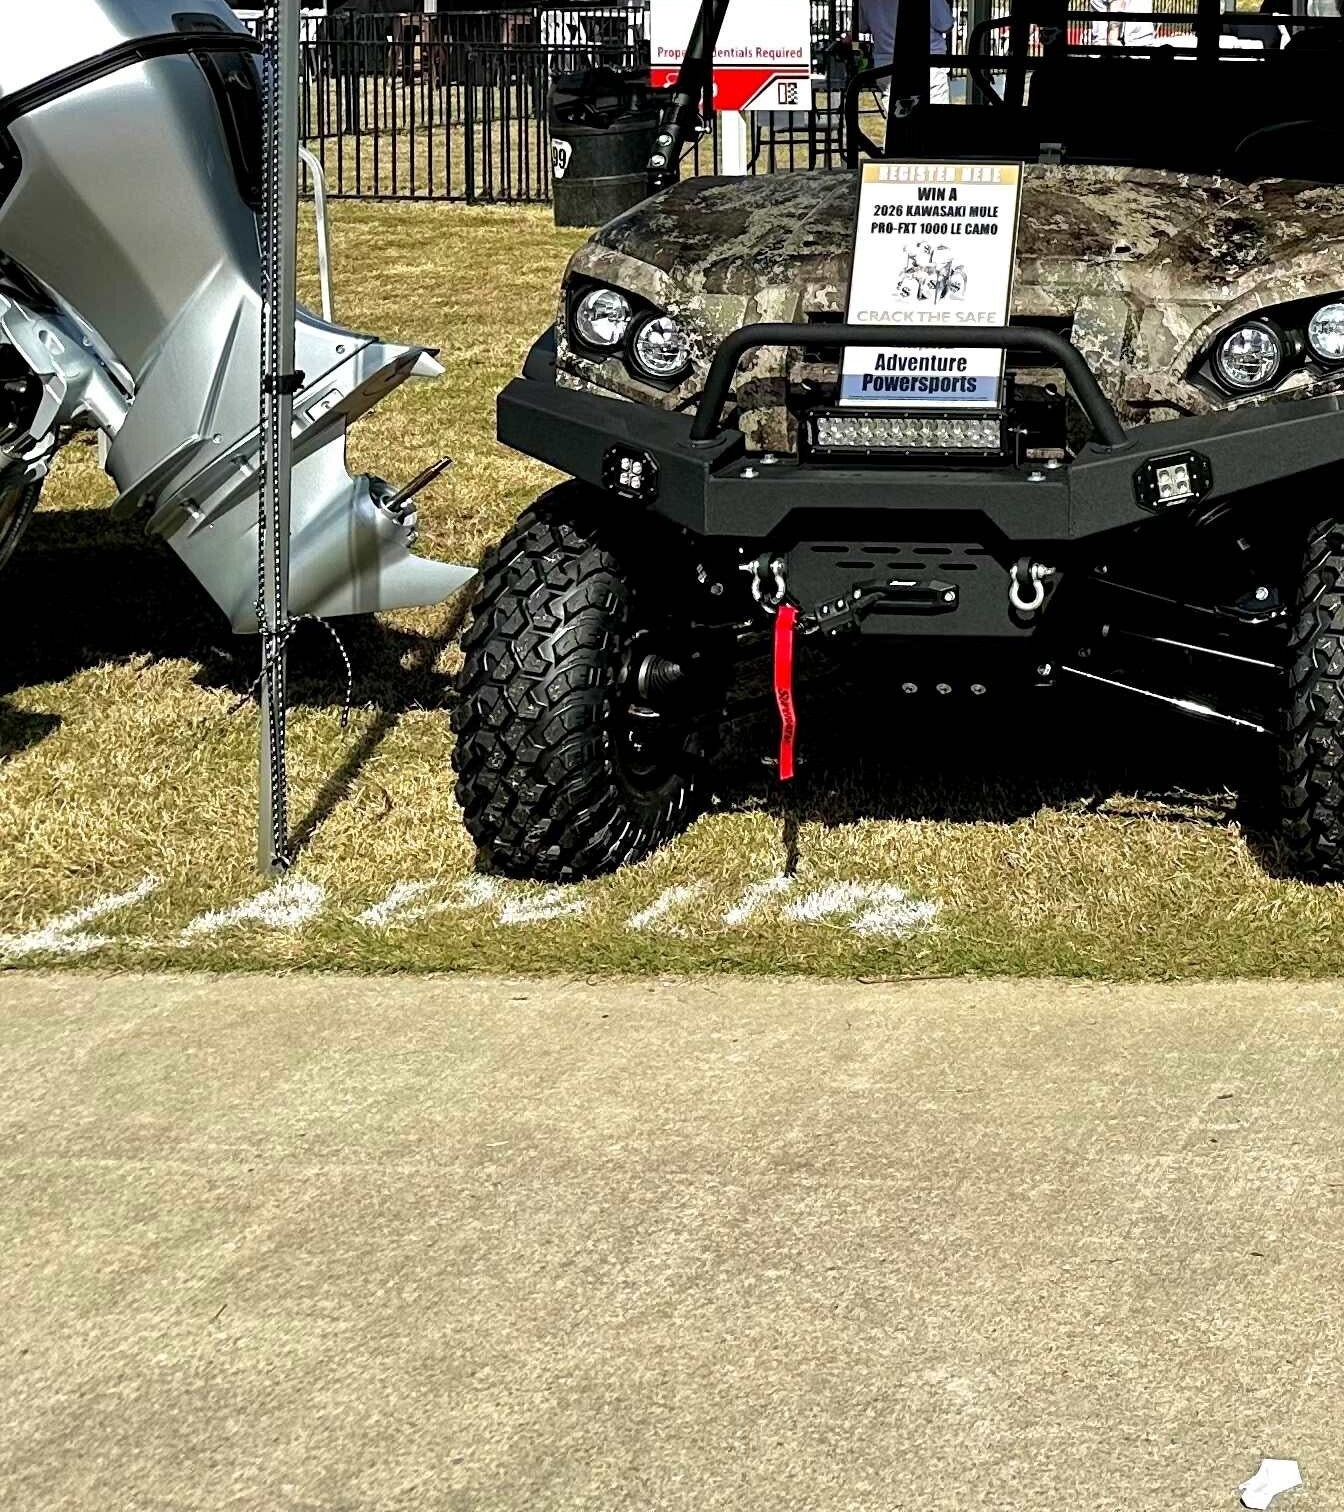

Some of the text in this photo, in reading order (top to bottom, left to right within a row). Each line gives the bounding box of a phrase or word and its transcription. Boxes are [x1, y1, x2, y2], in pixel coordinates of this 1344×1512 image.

[657, 46, 803, 60] Prope entials Required
[879, 166, 1001, 183] REGISTER HERE
[917, 187, 958, 201] WIN A
[873, 205, 999, 218] 2026 KAWASAKI MULE
[871, 222, 998, 235] PRO-FXT 1000 LE CAMO
[857, 310, 997, 324] CRACK THE SAFE
[875, 353, 967, 372] Adventure
[862, 374, 977, 393] Powersports
